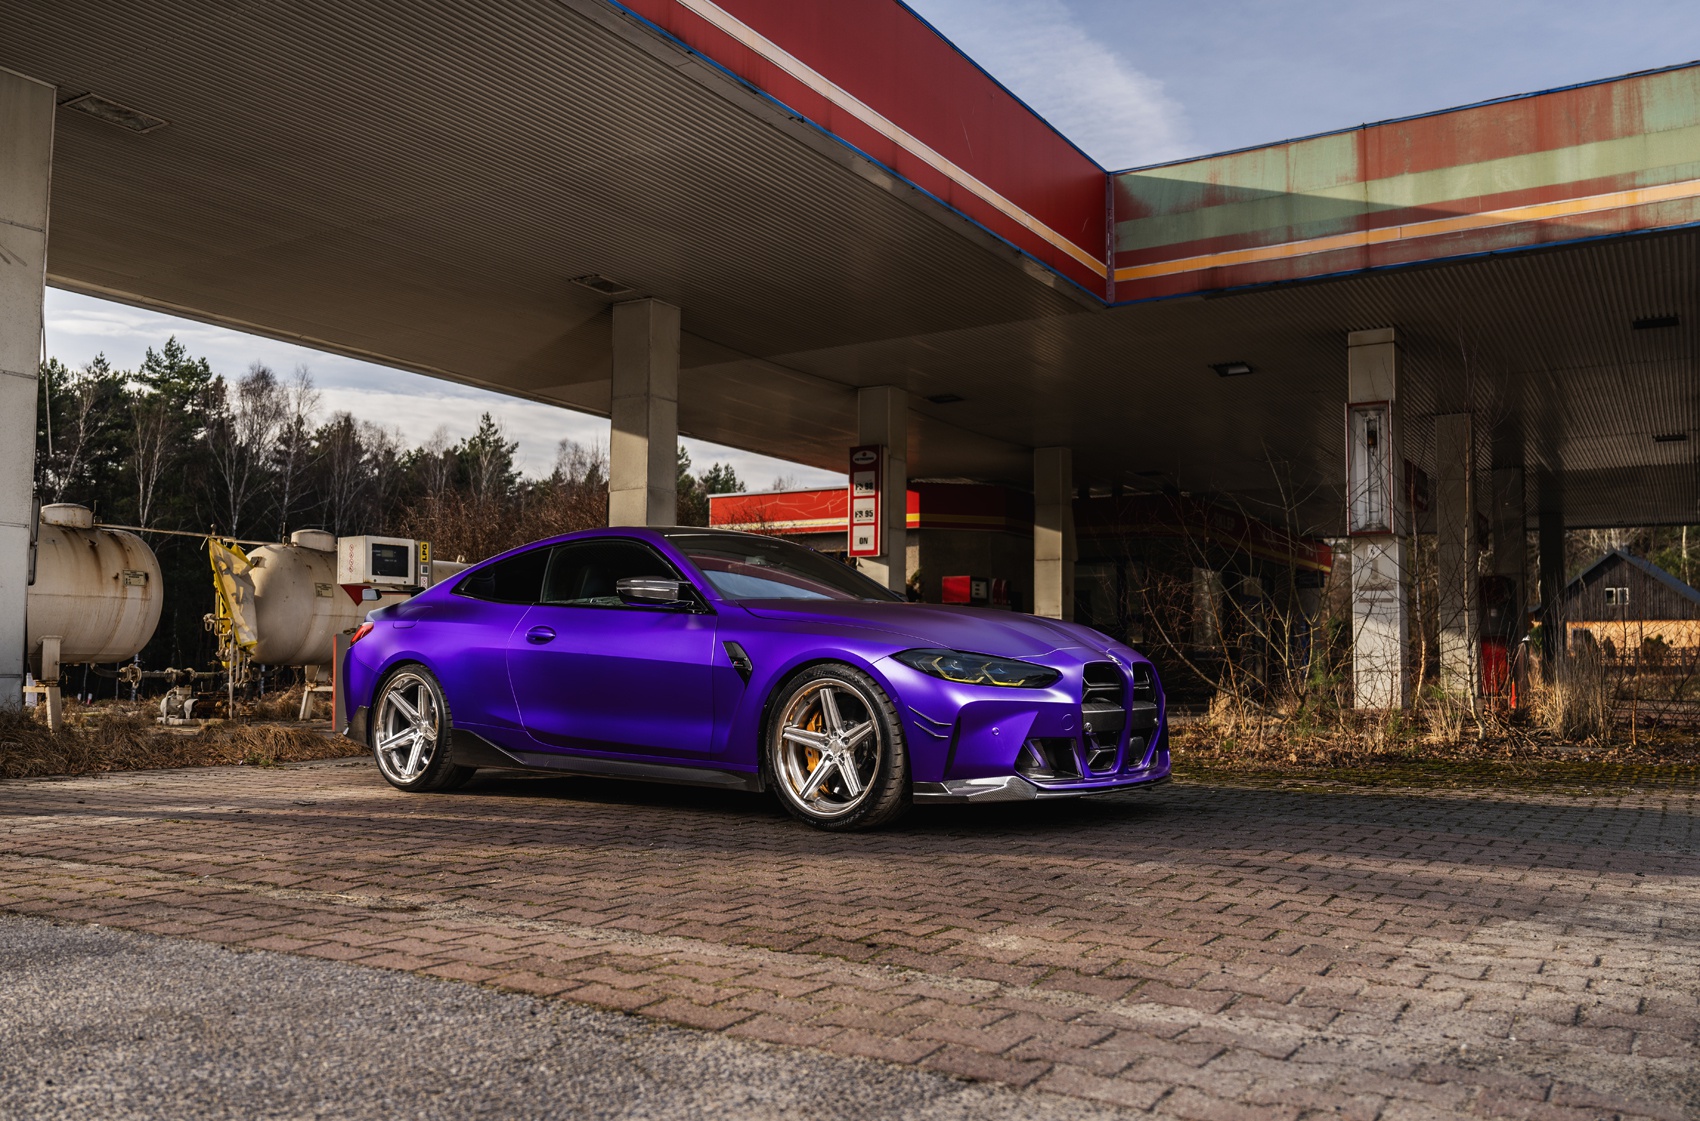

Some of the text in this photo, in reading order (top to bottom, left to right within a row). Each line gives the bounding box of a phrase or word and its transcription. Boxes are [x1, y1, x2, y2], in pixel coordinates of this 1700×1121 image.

[865, 482, 873, 490] 98
[865, 510, 873, 518] 95
[859, 537, 868, 545] ON
